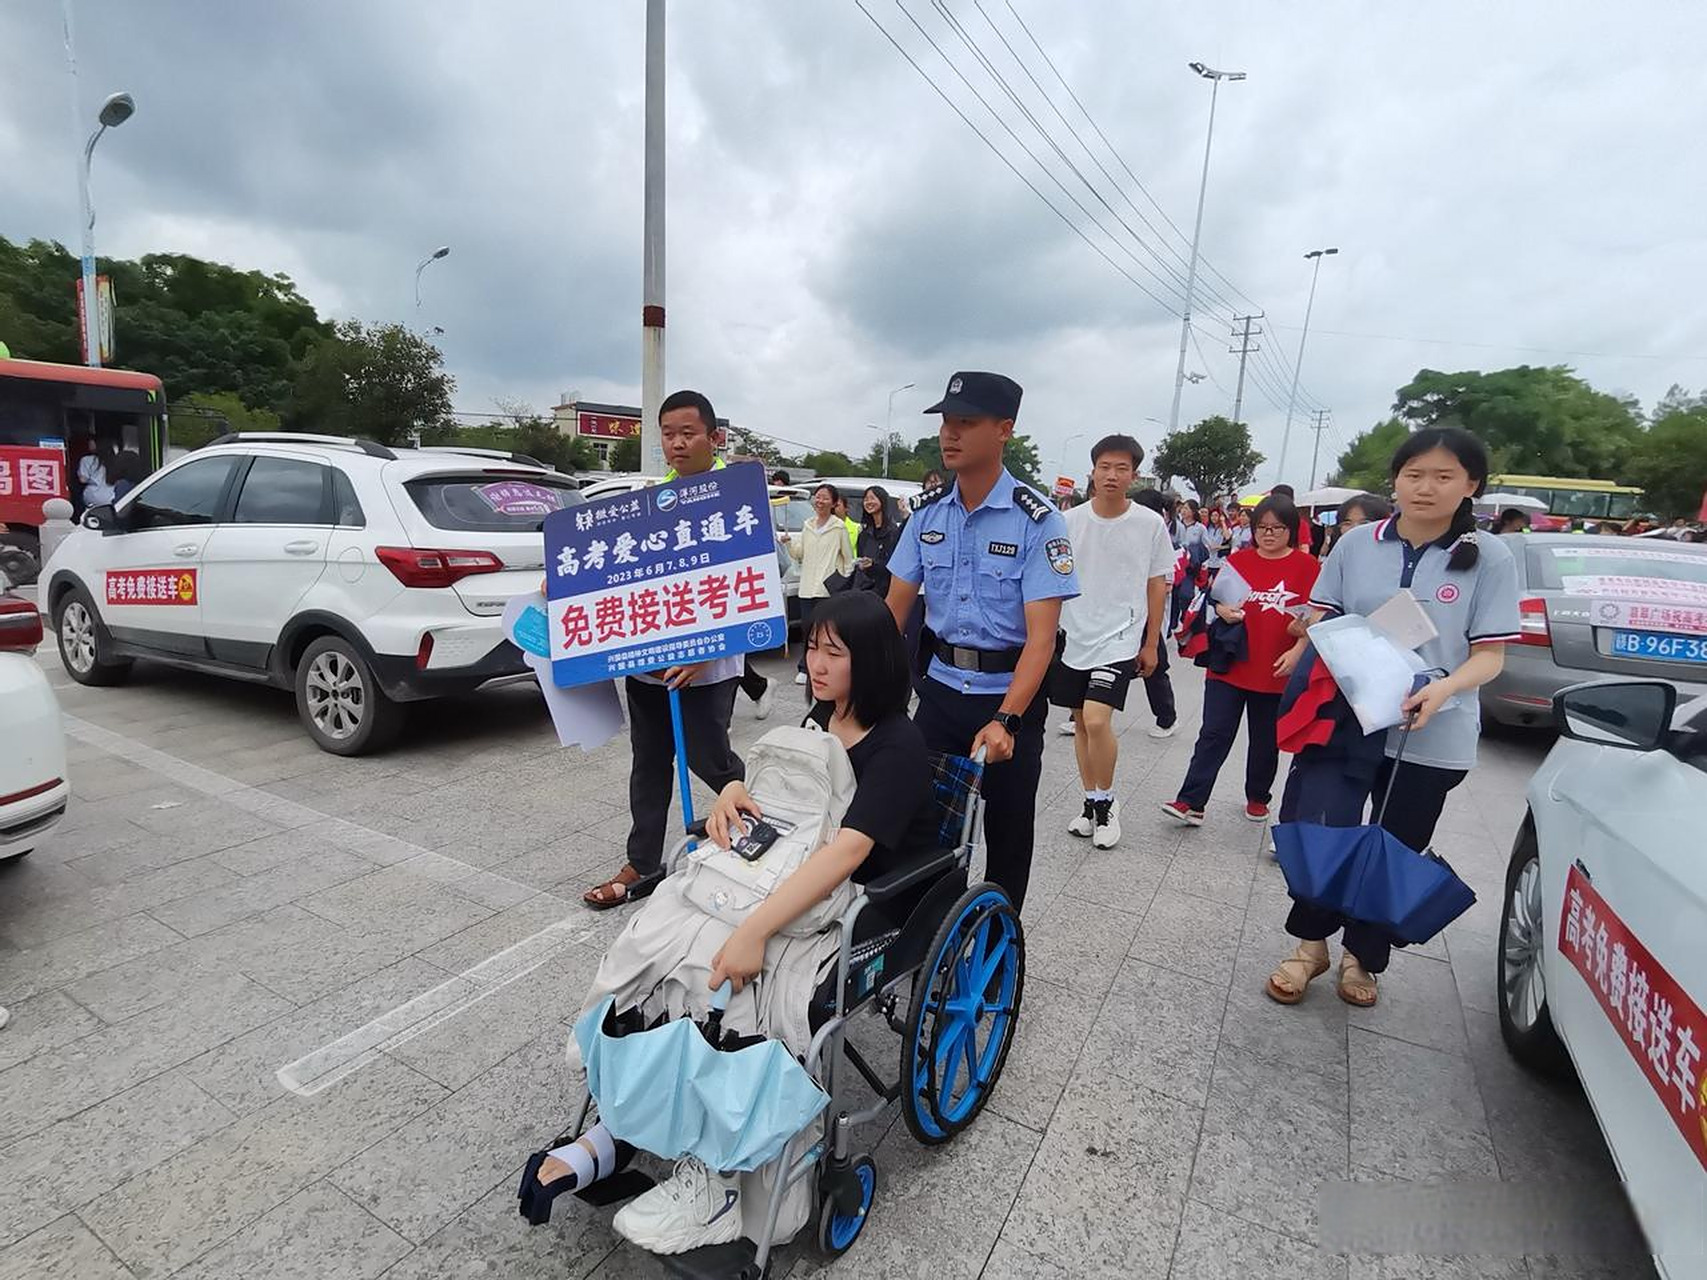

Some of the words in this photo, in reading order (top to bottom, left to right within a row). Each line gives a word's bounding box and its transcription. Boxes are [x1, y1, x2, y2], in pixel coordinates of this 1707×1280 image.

[679, 481, 718, 498] 洋河股份
[680, 490, 721, 505] YANGHE
[556, 505, 761, 578] 高考爱心直通车
[106, 574, 179, 602] 高考免费接送车
[560, 566, 770, 650] 免费接送考生
[1564, 888, 1701, 1114] 高考免费接送车
